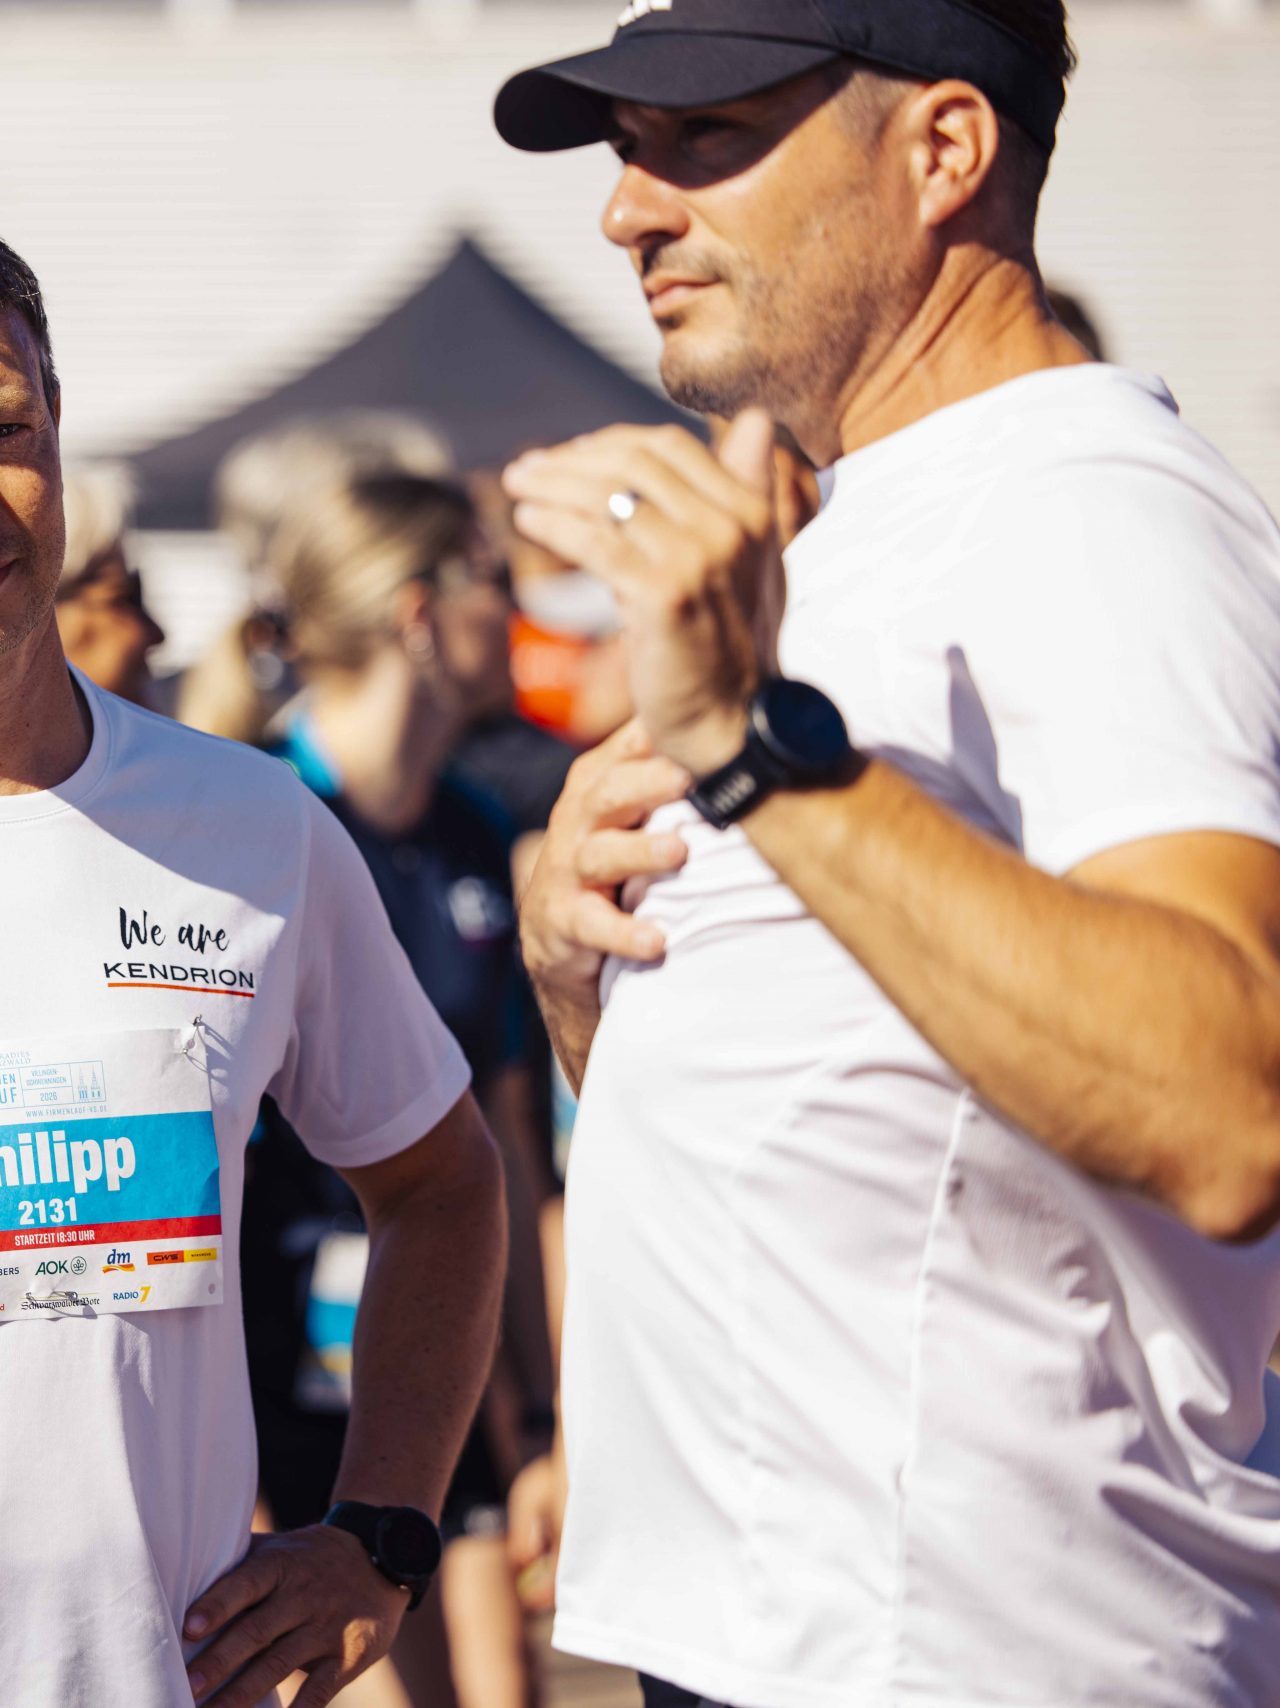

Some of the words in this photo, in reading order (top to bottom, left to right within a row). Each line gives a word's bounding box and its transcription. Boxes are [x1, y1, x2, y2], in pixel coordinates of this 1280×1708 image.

[118, 906, 166, 950] We
[178, 923, 230, 954] are
[103, 962, 255, 989] KENDRION
[18, 1197, 78, 1225] 2131
[14, 1232, 55, 1246] STARTZEIT
[56, 1231, 77, 1243] 18:30
[78, 1230, 95, 1241] UHR
[107, 1249, 131, 1265] dm
[35, 1260, 69, 1276] AOK
[113, 1291, 139, 1301] RADIO
[140, 1286, 151, 1304] 7
